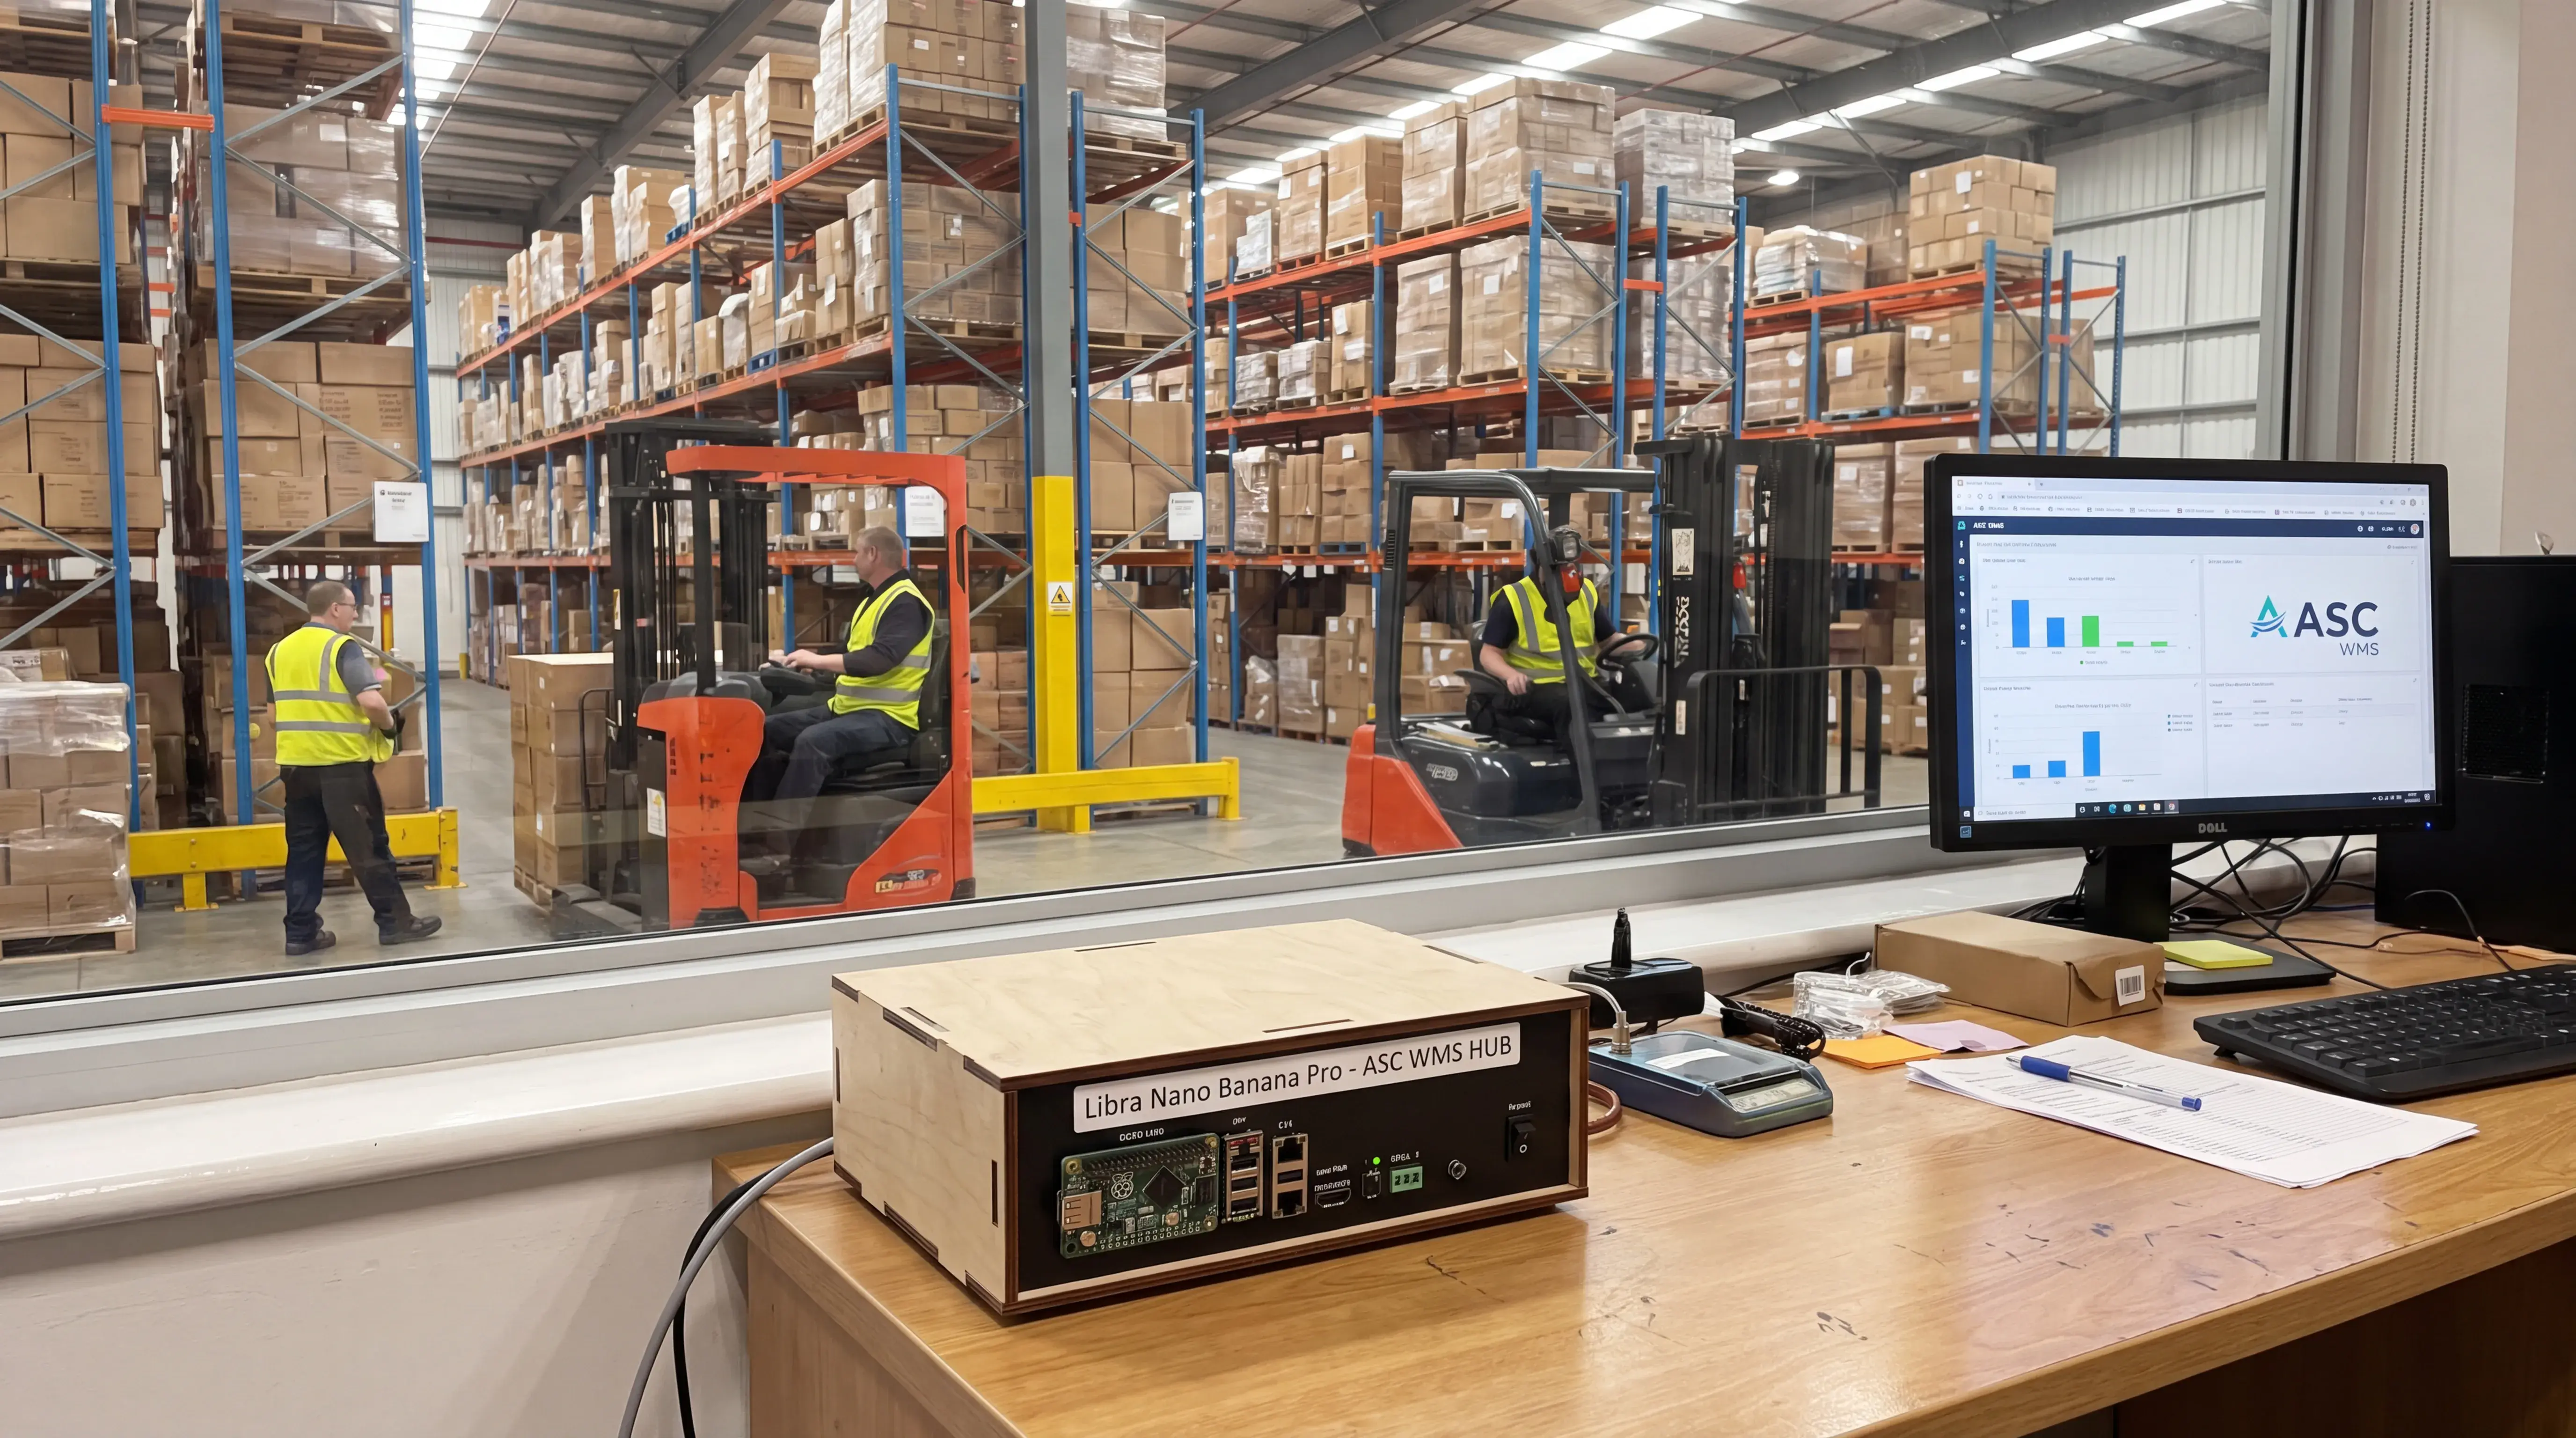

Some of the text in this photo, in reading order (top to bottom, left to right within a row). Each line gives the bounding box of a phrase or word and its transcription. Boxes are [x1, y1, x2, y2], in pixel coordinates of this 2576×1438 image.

[2293, 602, 2378, 637] ASC
[2340, 643, 2379, 656] WMS
[1085, 1093, 1142, 1119] Libra
[1151, 1085, 1211, 1109] Nano
[1219, 1072, 1299, 1098] Banana
[1308, 1064, 1342, 1085] Pro
[1362, 1051, 1403, 1076] ASC
[1409, 1042, 1463, 1068] WMS
[1470, 1035, 1512, 1060] HUB
